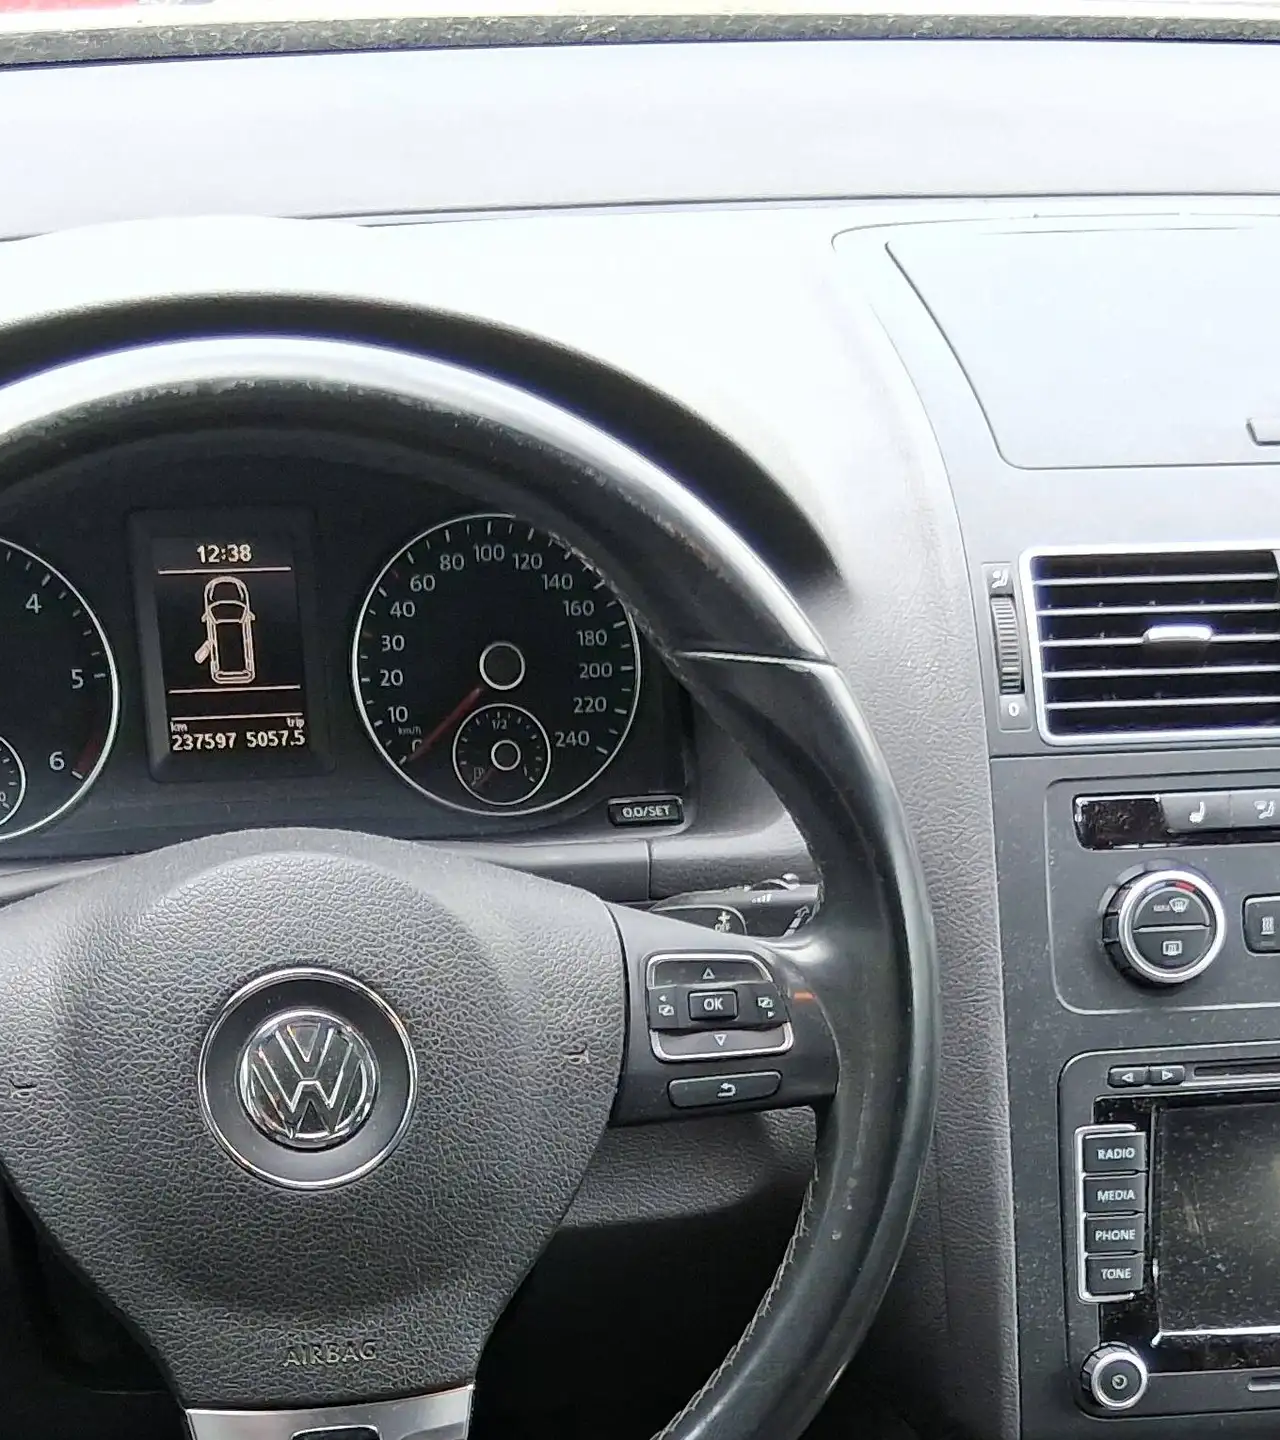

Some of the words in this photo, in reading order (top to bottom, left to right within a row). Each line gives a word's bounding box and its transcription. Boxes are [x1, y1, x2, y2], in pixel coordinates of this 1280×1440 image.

[196, 544, 251, 563] 12:38
[440, 553, 465, 571] 80
[474, 545, 505, 562] 100
[512, 553, 543, 570] 120
[410, 575, 436, 592] 60
[541, 573, 573, 591] 140
[25, 593, 42, 614] 4
[390, 600, 415, 618] 40
[563, 600, 595, 617] 160
[381, 634, 405, 652] 30
[577, 629, 607, 646] 180
[71, 669, 84, 689] 5
[380, 669, 403, 687] 20
[579, 662, 613, 679] 200
[573, 696, 607, 714] 220
[1008, 702, 1020, 717] 0
[286, 717, 305, 729] trip
[388, 706, 409, 723] 10
[170, 720, 188, 733] km
[171, 733, 237, 751] 237597
[246, 730, 306, 748] 5057.5
[555, 731, 590, 749] 240
[49, 751, 65, 771] 6
[704, 998, 723, 1011] OK
[244, 1016, 372, 1143] VW
[1097, 1147, 1135, 1160] RADIO
[1097, 1190, 1135, 1202] MEDIA
[1095, 1229, 1136, 1241] PHONE
[1101, 1268, 1131, 1280] TONE
[282, 1342, 376, 1367] AIRBAG
